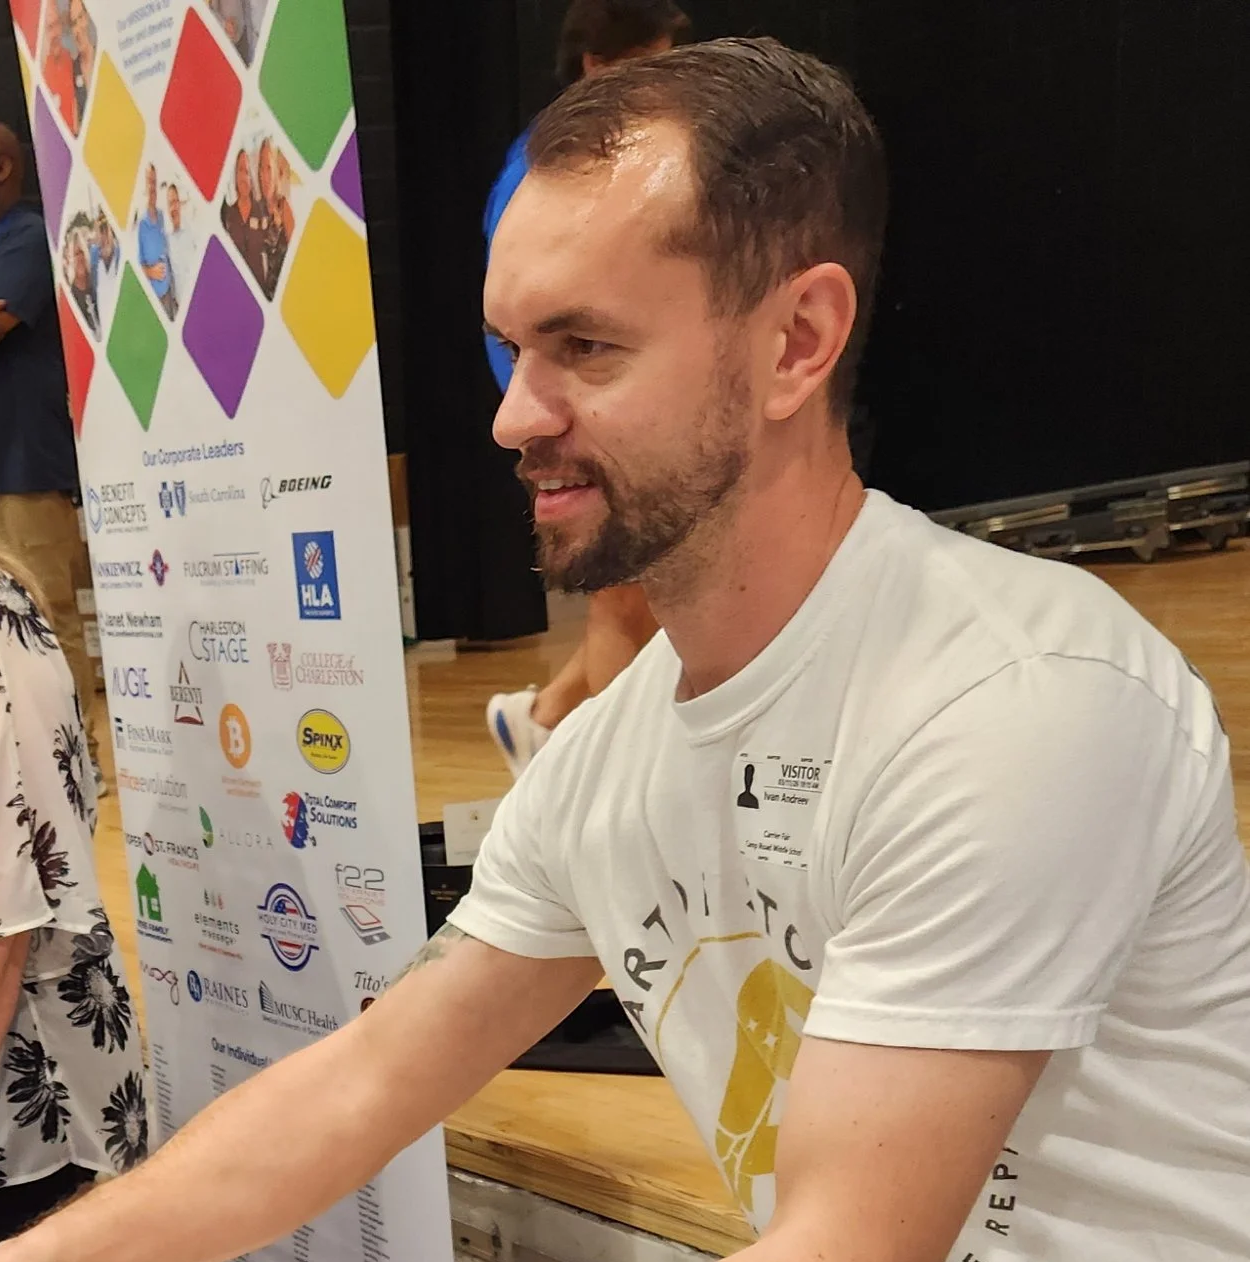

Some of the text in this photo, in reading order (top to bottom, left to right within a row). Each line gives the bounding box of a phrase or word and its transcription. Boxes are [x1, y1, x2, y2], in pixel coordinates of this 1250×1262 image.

[142, 439, 246, 468] Our Corporate Leaders
[100, 482, 135, 503] BENEFIT
[189, 484, 246, 504] South Carolina
[278, 475, 332, 493] BOEING
[103, 504, 147, 524] CONCEPTS
[183, 557, 269, 578] FULCRUM STAFFING
[301, 583, 335, 607] HLA
[104, 611, 163, 628] Janet Newham
[202, 638, 250, 663] STAGE
[301, 652, 344, 669] COLLEGE
[295, 665, 365, 686] CHARLESTON
[302, 727, 344, 751] SPINX
[781, 764, 821, 781] VISITOR
[304, 792, 358, 812] TOTAL COMFORT
[764, 792, 810, 806] Ivan Andreev
[309, 807, 358, 830] SOLUTIONS
[166, 841, 199, 861] FRANCIS
[334, 863, 387, 892] f22
[194, 912, 240, 935] elements
[280, 916, 297, 931] CITY
[300, 921, 317, 935] MED
[203, 977, 249, 1009] RAINES
[354, 971, 389, 994] Tito's
[273, 1001, 307, 1024] MUSC
[308, 1011, 340, 1032] Health
[211, 1037, 268, 1067] Our Individual
